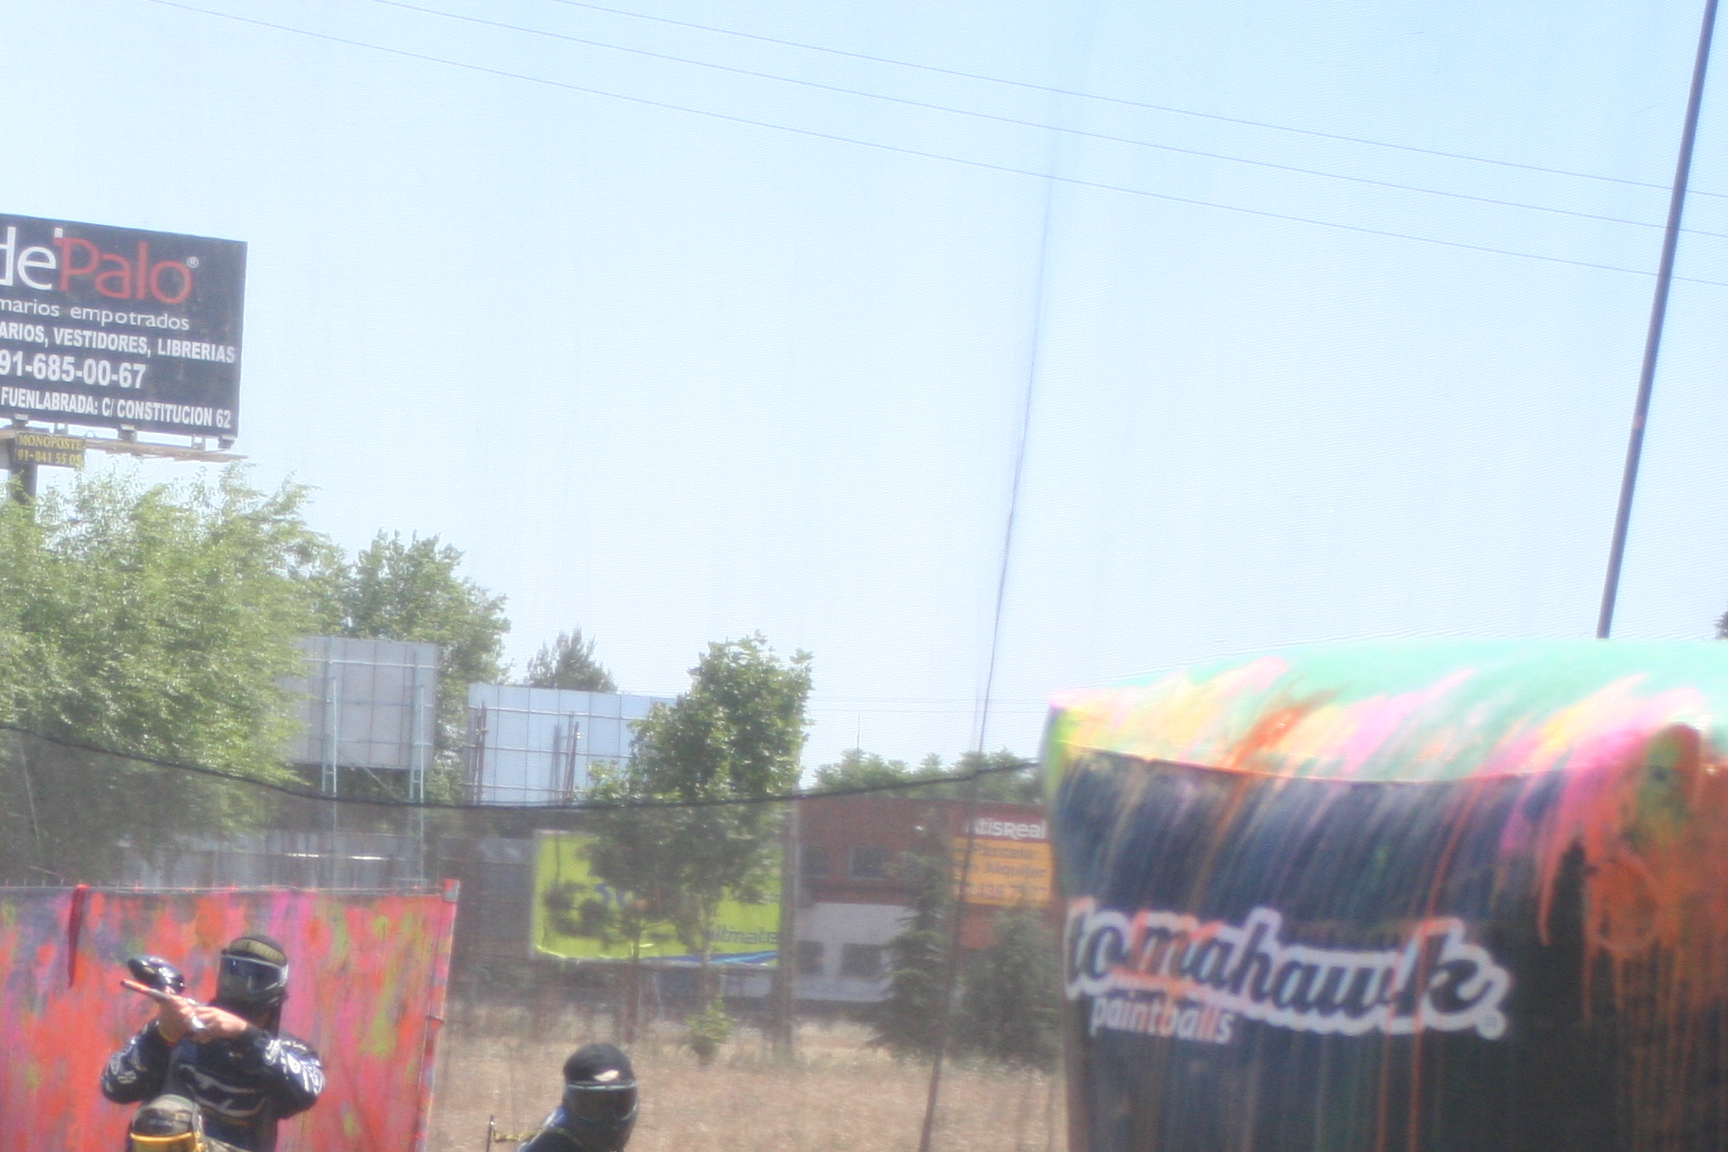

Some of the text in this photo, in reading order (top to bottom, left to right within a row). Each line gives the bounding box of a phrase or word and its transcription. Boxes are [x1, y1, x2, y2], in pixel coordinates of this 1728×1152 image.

[70, 306, 190, 331] empotrados
[54, 327, 151, 358] VESTIDORES,
[158, 337, 236, 364] LIBRERIAS
[0, 386, 99, 415] FUENLABRADA:
[101, 398, 114, 418] C/
[117, 399, 213, 427] CONSTITUCION
[216, 409, 231, 429] 62
[19, 434, 83, 450] MONOPOSTE
[1089, 996, 1235, 1045] paintballs
